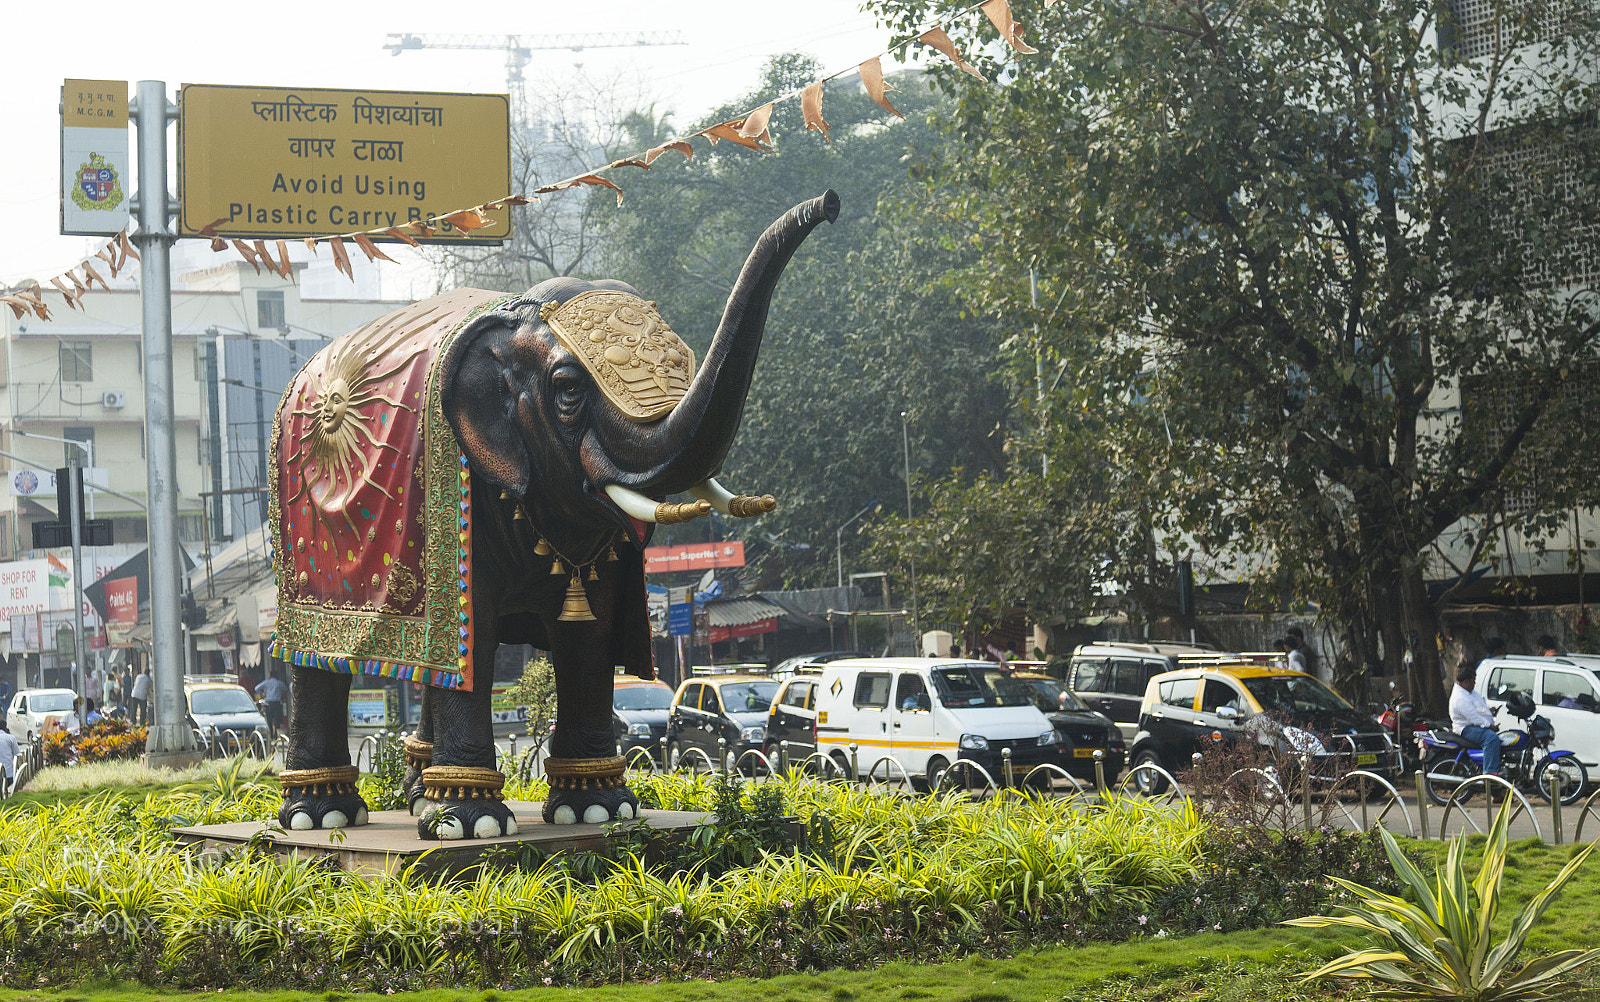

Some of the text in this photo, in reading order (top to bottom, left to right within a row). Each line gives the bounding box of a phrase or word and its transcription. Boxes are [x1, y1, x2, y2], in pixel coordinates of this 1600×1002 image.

[251, 94, 444, 127] प्लास्टिक पिशव्यांचा
[288, 138, 404, 162] वापर टाळा
[272, 172, 426, 201] Avoid Using
[229, 203, 318, 225] Plastic
[329, 205, 397, 228] Carry
[1, 570, 37, 585] SHOP FOR
[10, 586, 28, 600] RENT
